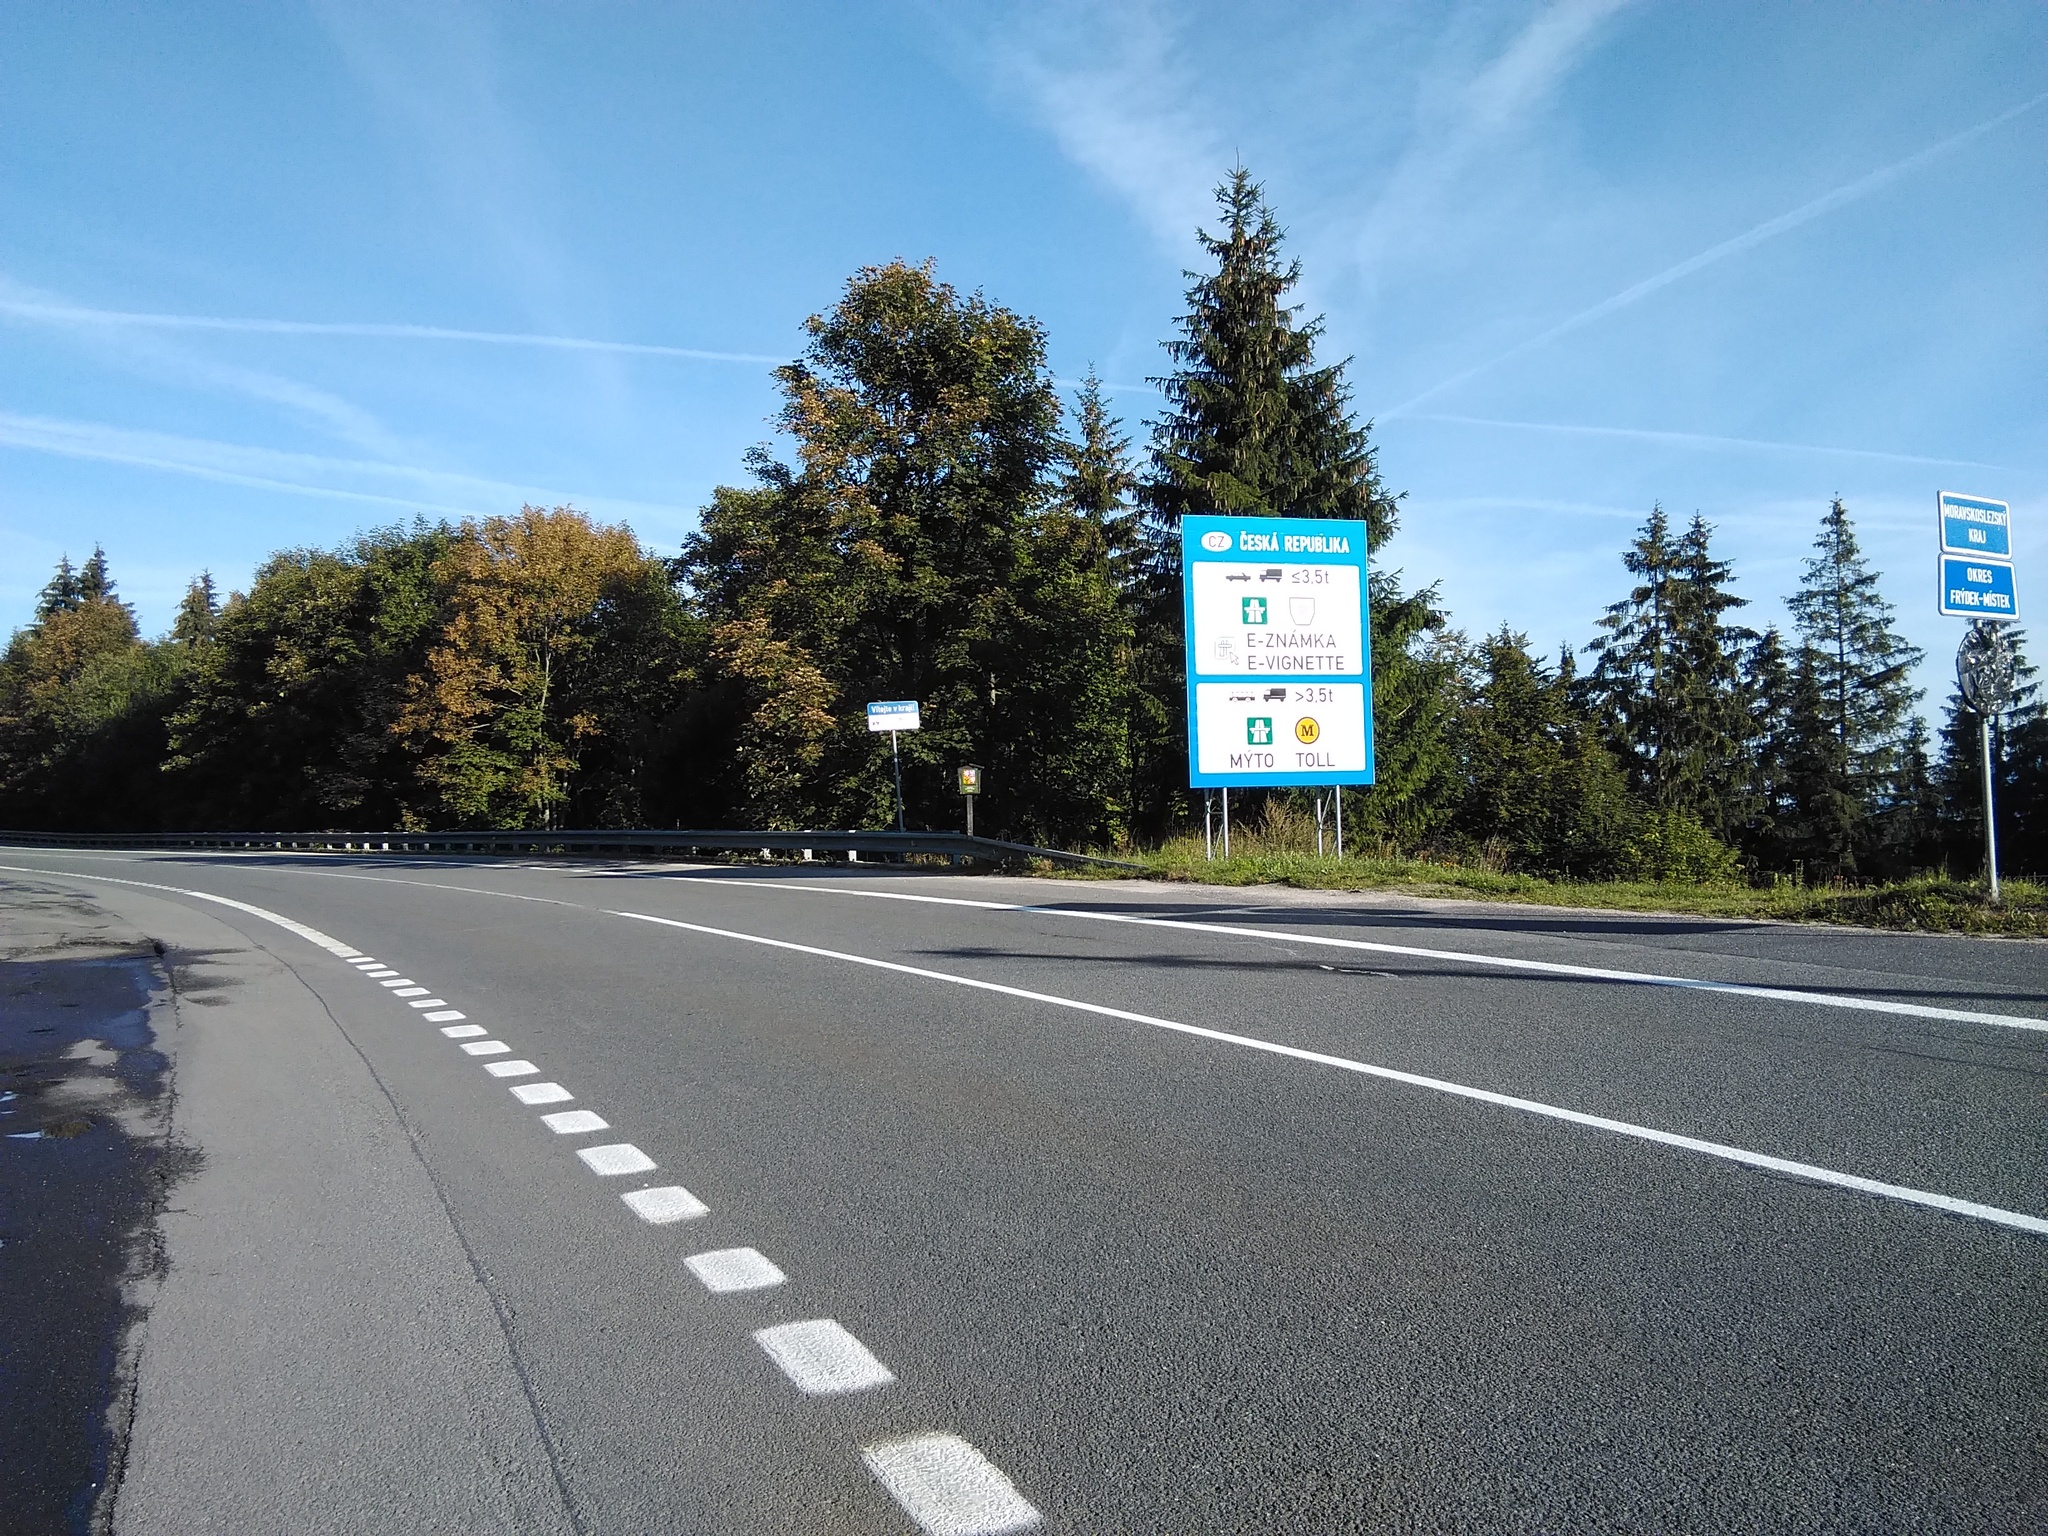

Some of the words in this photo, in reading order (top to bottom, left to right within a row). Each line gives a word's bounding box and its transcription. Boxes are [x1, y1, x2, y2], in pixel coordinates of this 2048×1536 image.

[1944, 503, 2006, 526] MORAVSKOSLEZSKÝ
[1208, 535, 1225, 548] CZ
[1239, 530, 1280, 551] ČESKÁ
[1284, 535, 1350, 553] REPUBLIKA
[1968, 528, 1986, 544] KRAJ
[1966, 567, 1993, 584] OKRES
[1950, 587, 2011, 608] FRÝDEK-MÍSTEK
[1247, 630, 1337, 648] E-ZNÁMKA
[1248, 655, 1345, 670] E-VIGNETTE
[1301, 724, 1314, 737] M
[1230, 750, 1274, 768] MÝTO
[1295, 752, 1336, 767] TOLL
